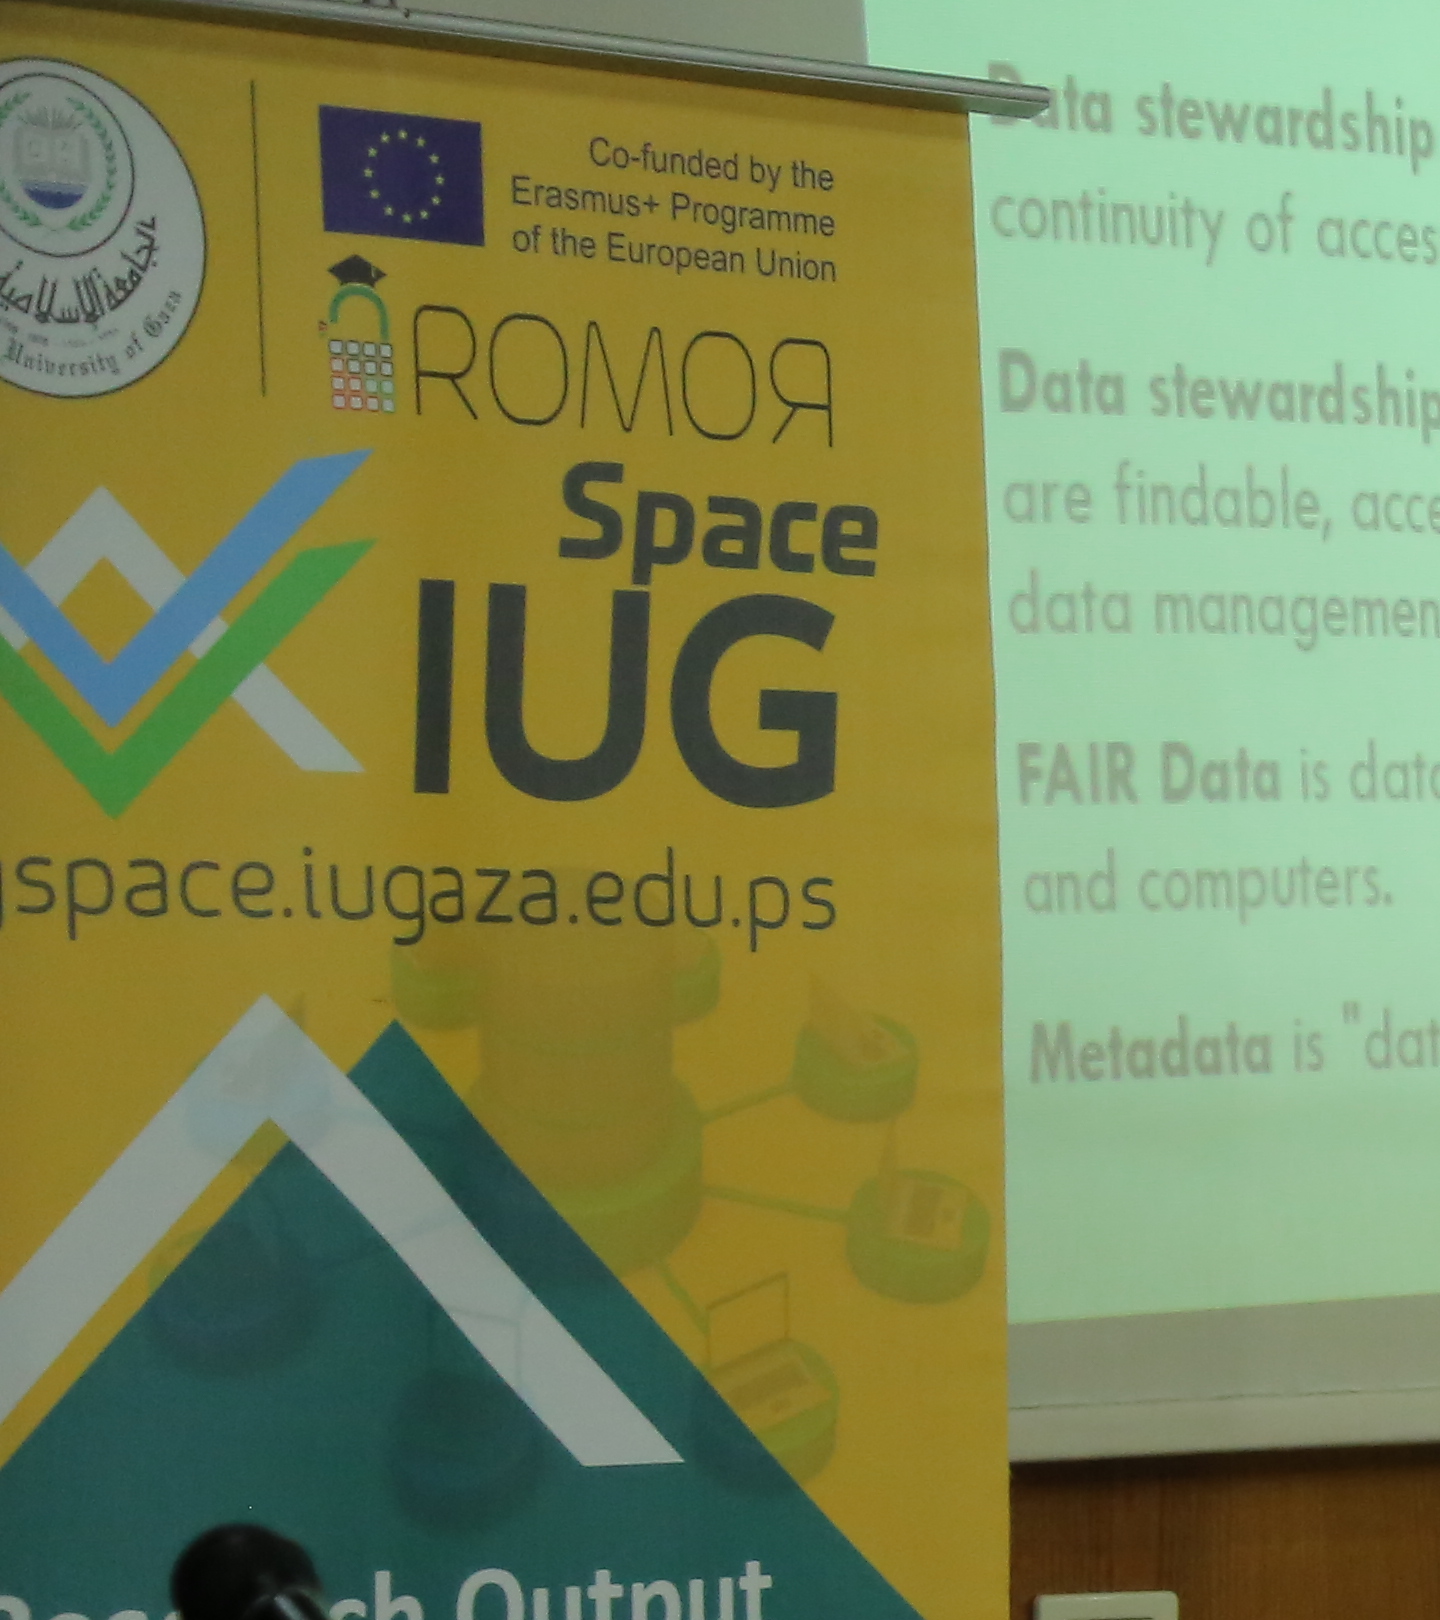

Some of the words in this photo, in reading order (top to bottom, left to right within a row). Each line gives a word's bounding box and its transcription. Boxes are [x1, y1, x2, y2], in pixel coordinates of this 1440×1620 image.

[590, 136, 738, 181] Co-funded
[750, 155, 782, 193] by
[792, 159, 834, 191] the
[1135, 82, 1436, 175] stewardship
[511, 174, 659, 217] Erasmus+
[671, 191, 836, 237] Programme
[992, 188, 1226, 267] continuity
[1246, 190, 1295, 254] of
[512, 225, 542, 253] of
[551, 227, 597, 259] the
[607, 232, 745, 276] European
[756, 248, 837, 283] Union
[1001, 348, 1126, 415] Data
[558, 460, 880, 587] Space
[1005, 481, 1093, 524] are
[1113, 459, 1333, 542] findable,
[1010, 569, 1133, 634] data
[413, 577, 838, 810] IUG
[1019, 741, 1138, 804] FAIR
[1160, 741, 1281, 804] Data
[1300, 748, 1331, 802] is
[0, 846, 838, 954] space.iugaza.edu.ps
[1024, 847, 1118, 913] and
[1138, 857, 1394, 924] computers.
[1031, 1013, 1272, 1083] Metadata
[1293, 1019, 1325, 1072] is
